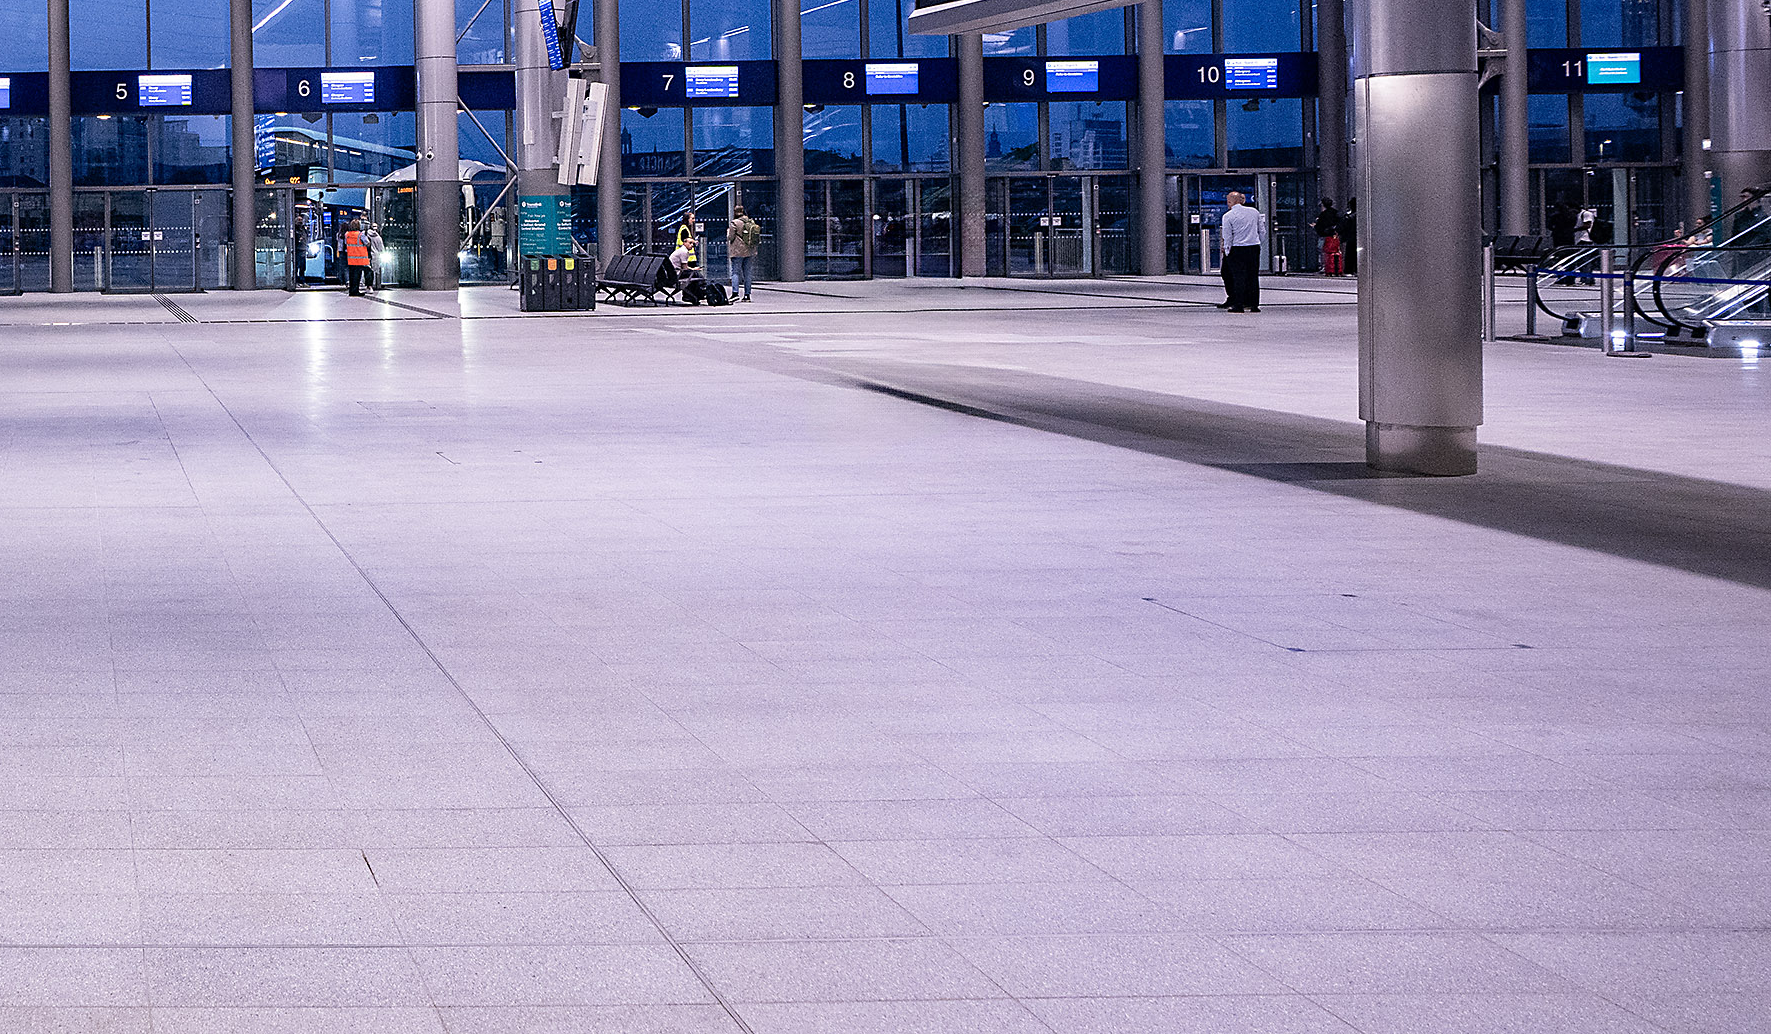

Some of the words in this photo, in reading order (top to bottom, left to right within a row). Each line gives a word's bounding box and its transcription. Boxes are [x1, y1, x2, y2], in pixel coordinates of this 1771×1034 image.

[1197, 65, 1220, 83] 10
[1562, 60, 1582, 77] 11
[662, 74, 675, 91] 7
[843, 72, 855, 88] 8
[1023, 69, 1035, 86] 9
[115, 83, 128, 100] 5
[298, 80, 311, 97] 6
